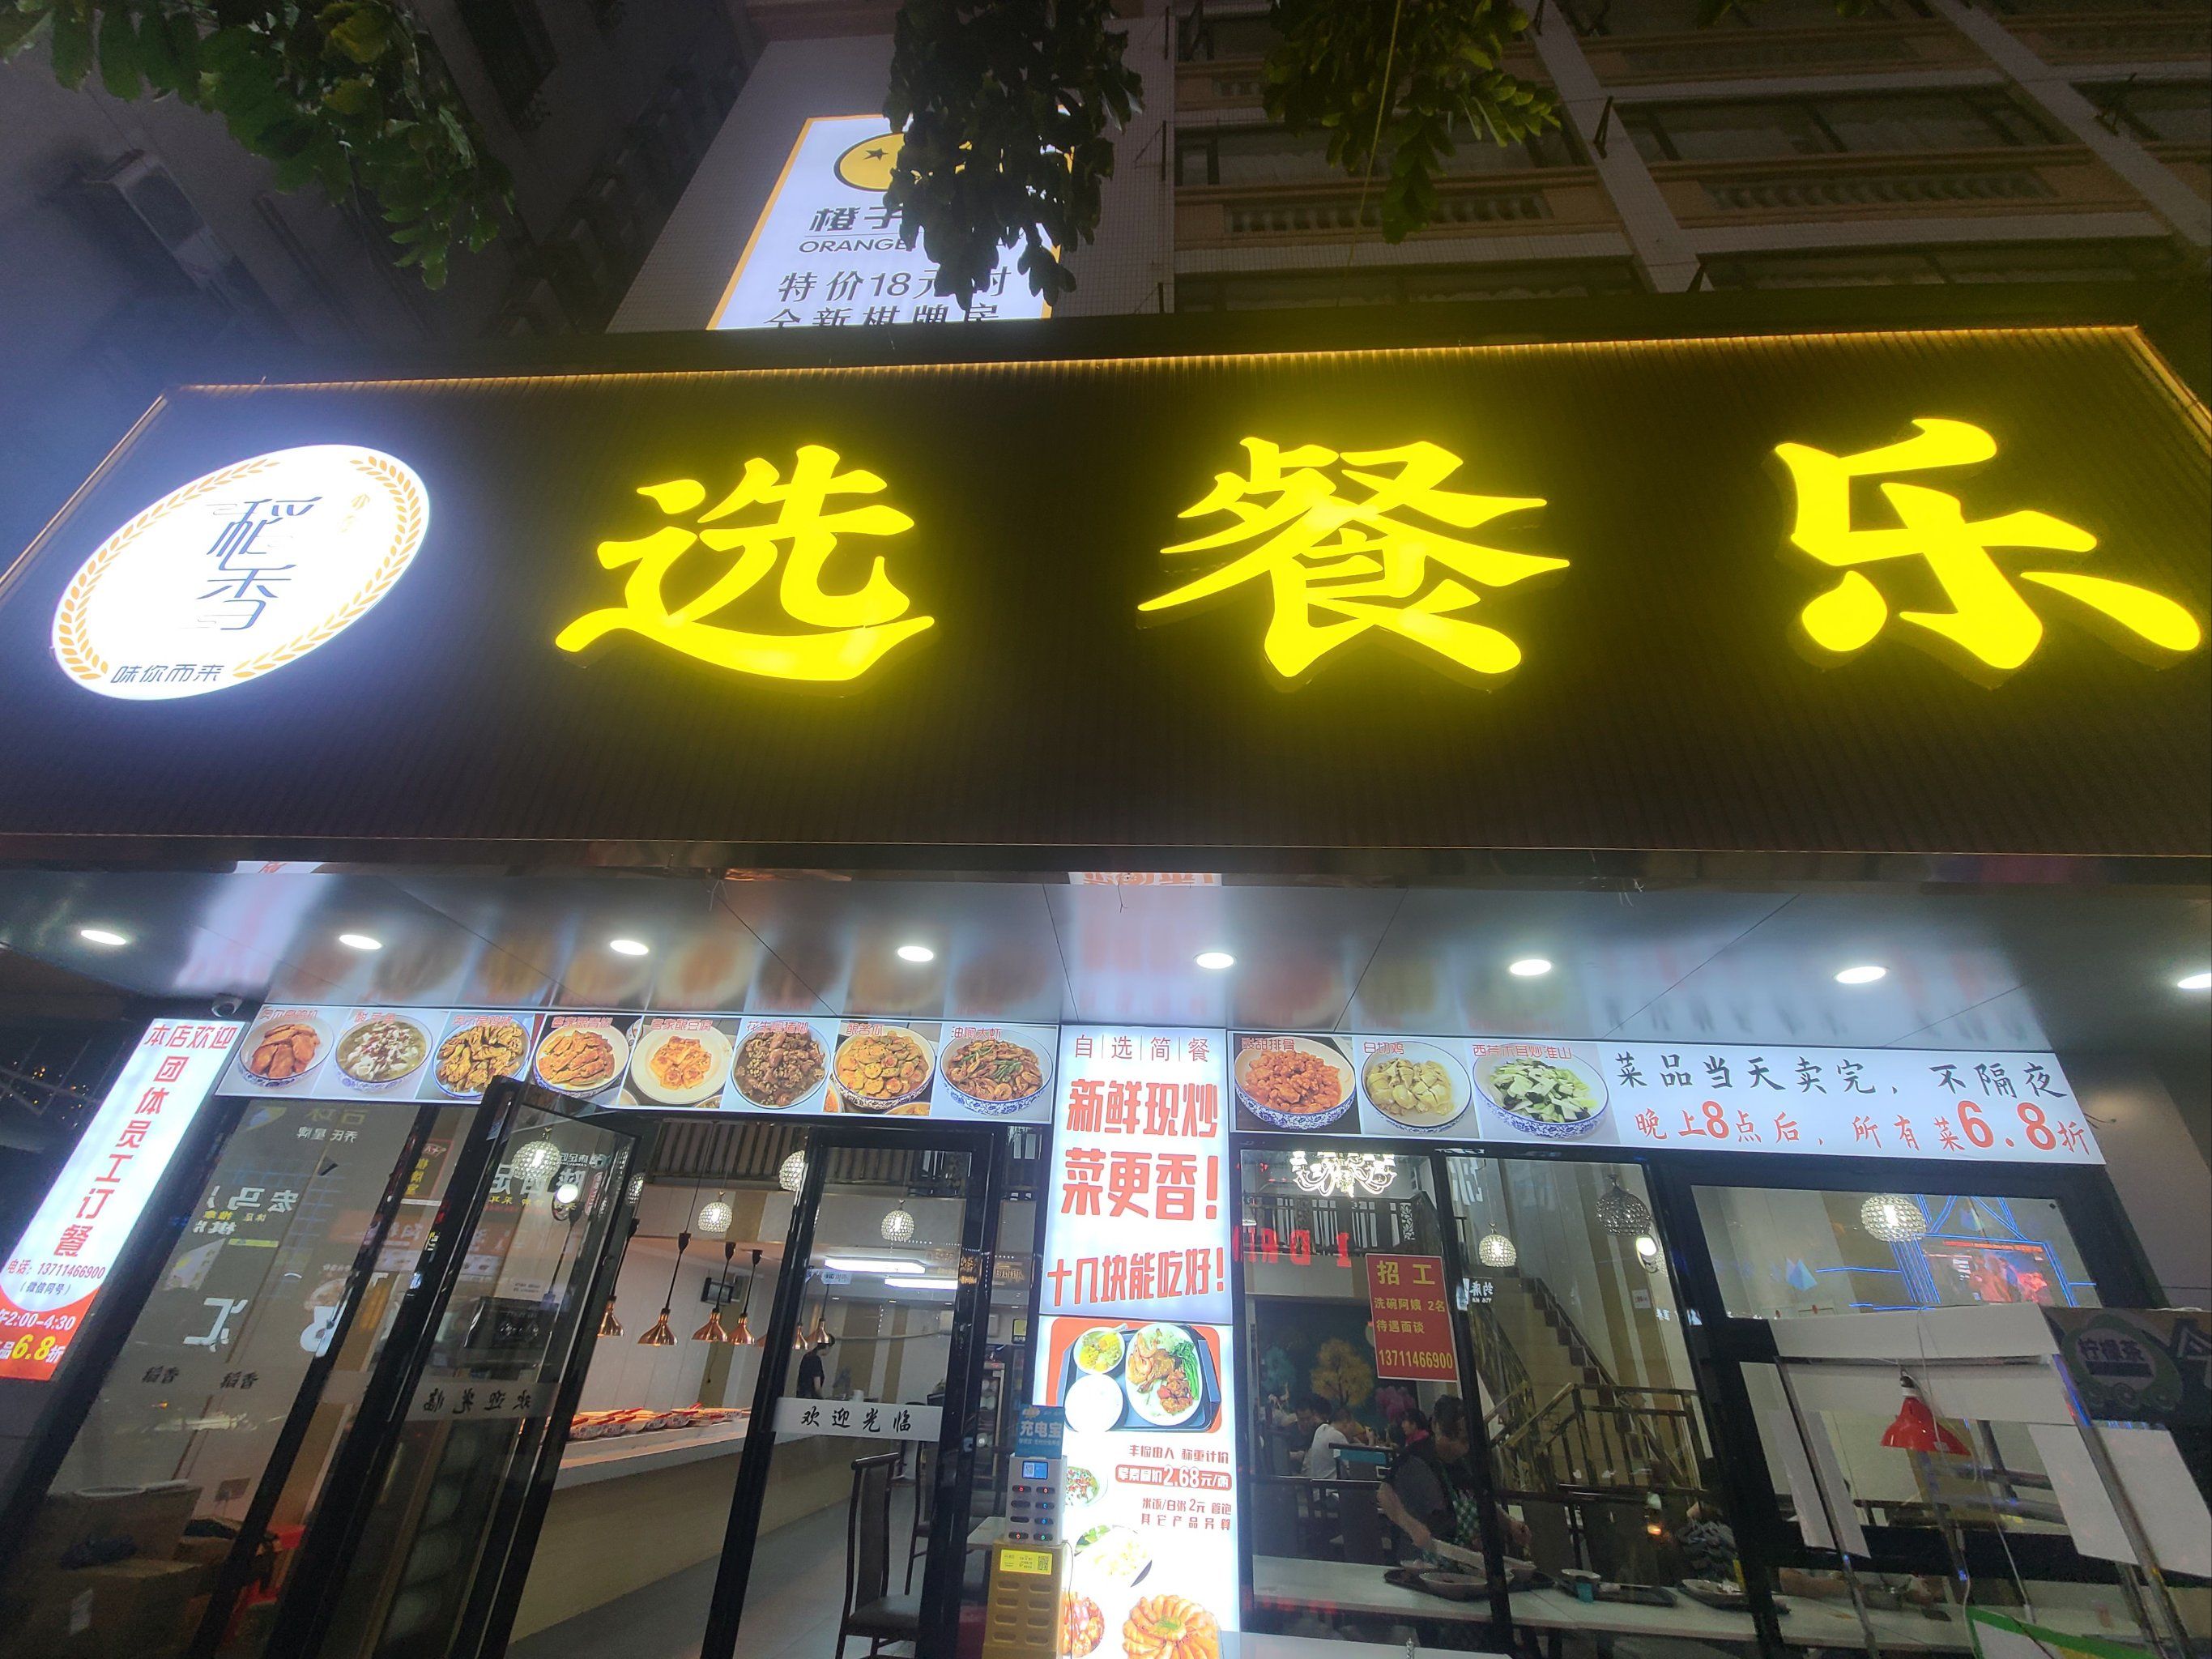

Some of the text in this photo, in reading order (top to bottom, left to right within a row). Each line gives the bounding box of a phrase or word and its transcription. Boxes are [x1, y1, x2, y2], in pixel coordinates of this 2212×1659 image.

[555, 418, 2201, 680] 选餐乐
[110, 663, 225, 684] 味你而来
[143, 1024, 238, 1050] 本店欢迎
[1074, 1034, 1211, 1063] 自选简餐
[1240, 1037, 1295, 1051] 酸甜排骨
[1363, 1042, 1404, 1055] 白切鸡
[1066, 1078, 1218, 1137] 新鲜现炒
[53, 1055, 190, 1258] 团体员工订餐
[1376, 1260, 1435, 1286] 招工
[1375, 1319, 1426, 1334] 待遇面谈
[1379, 1349, 1453, 1369] 13711466900
[800, 1405, 912, 1433] 欢迎光临
[1019, 1420, 1063, 1439] 充电宝
